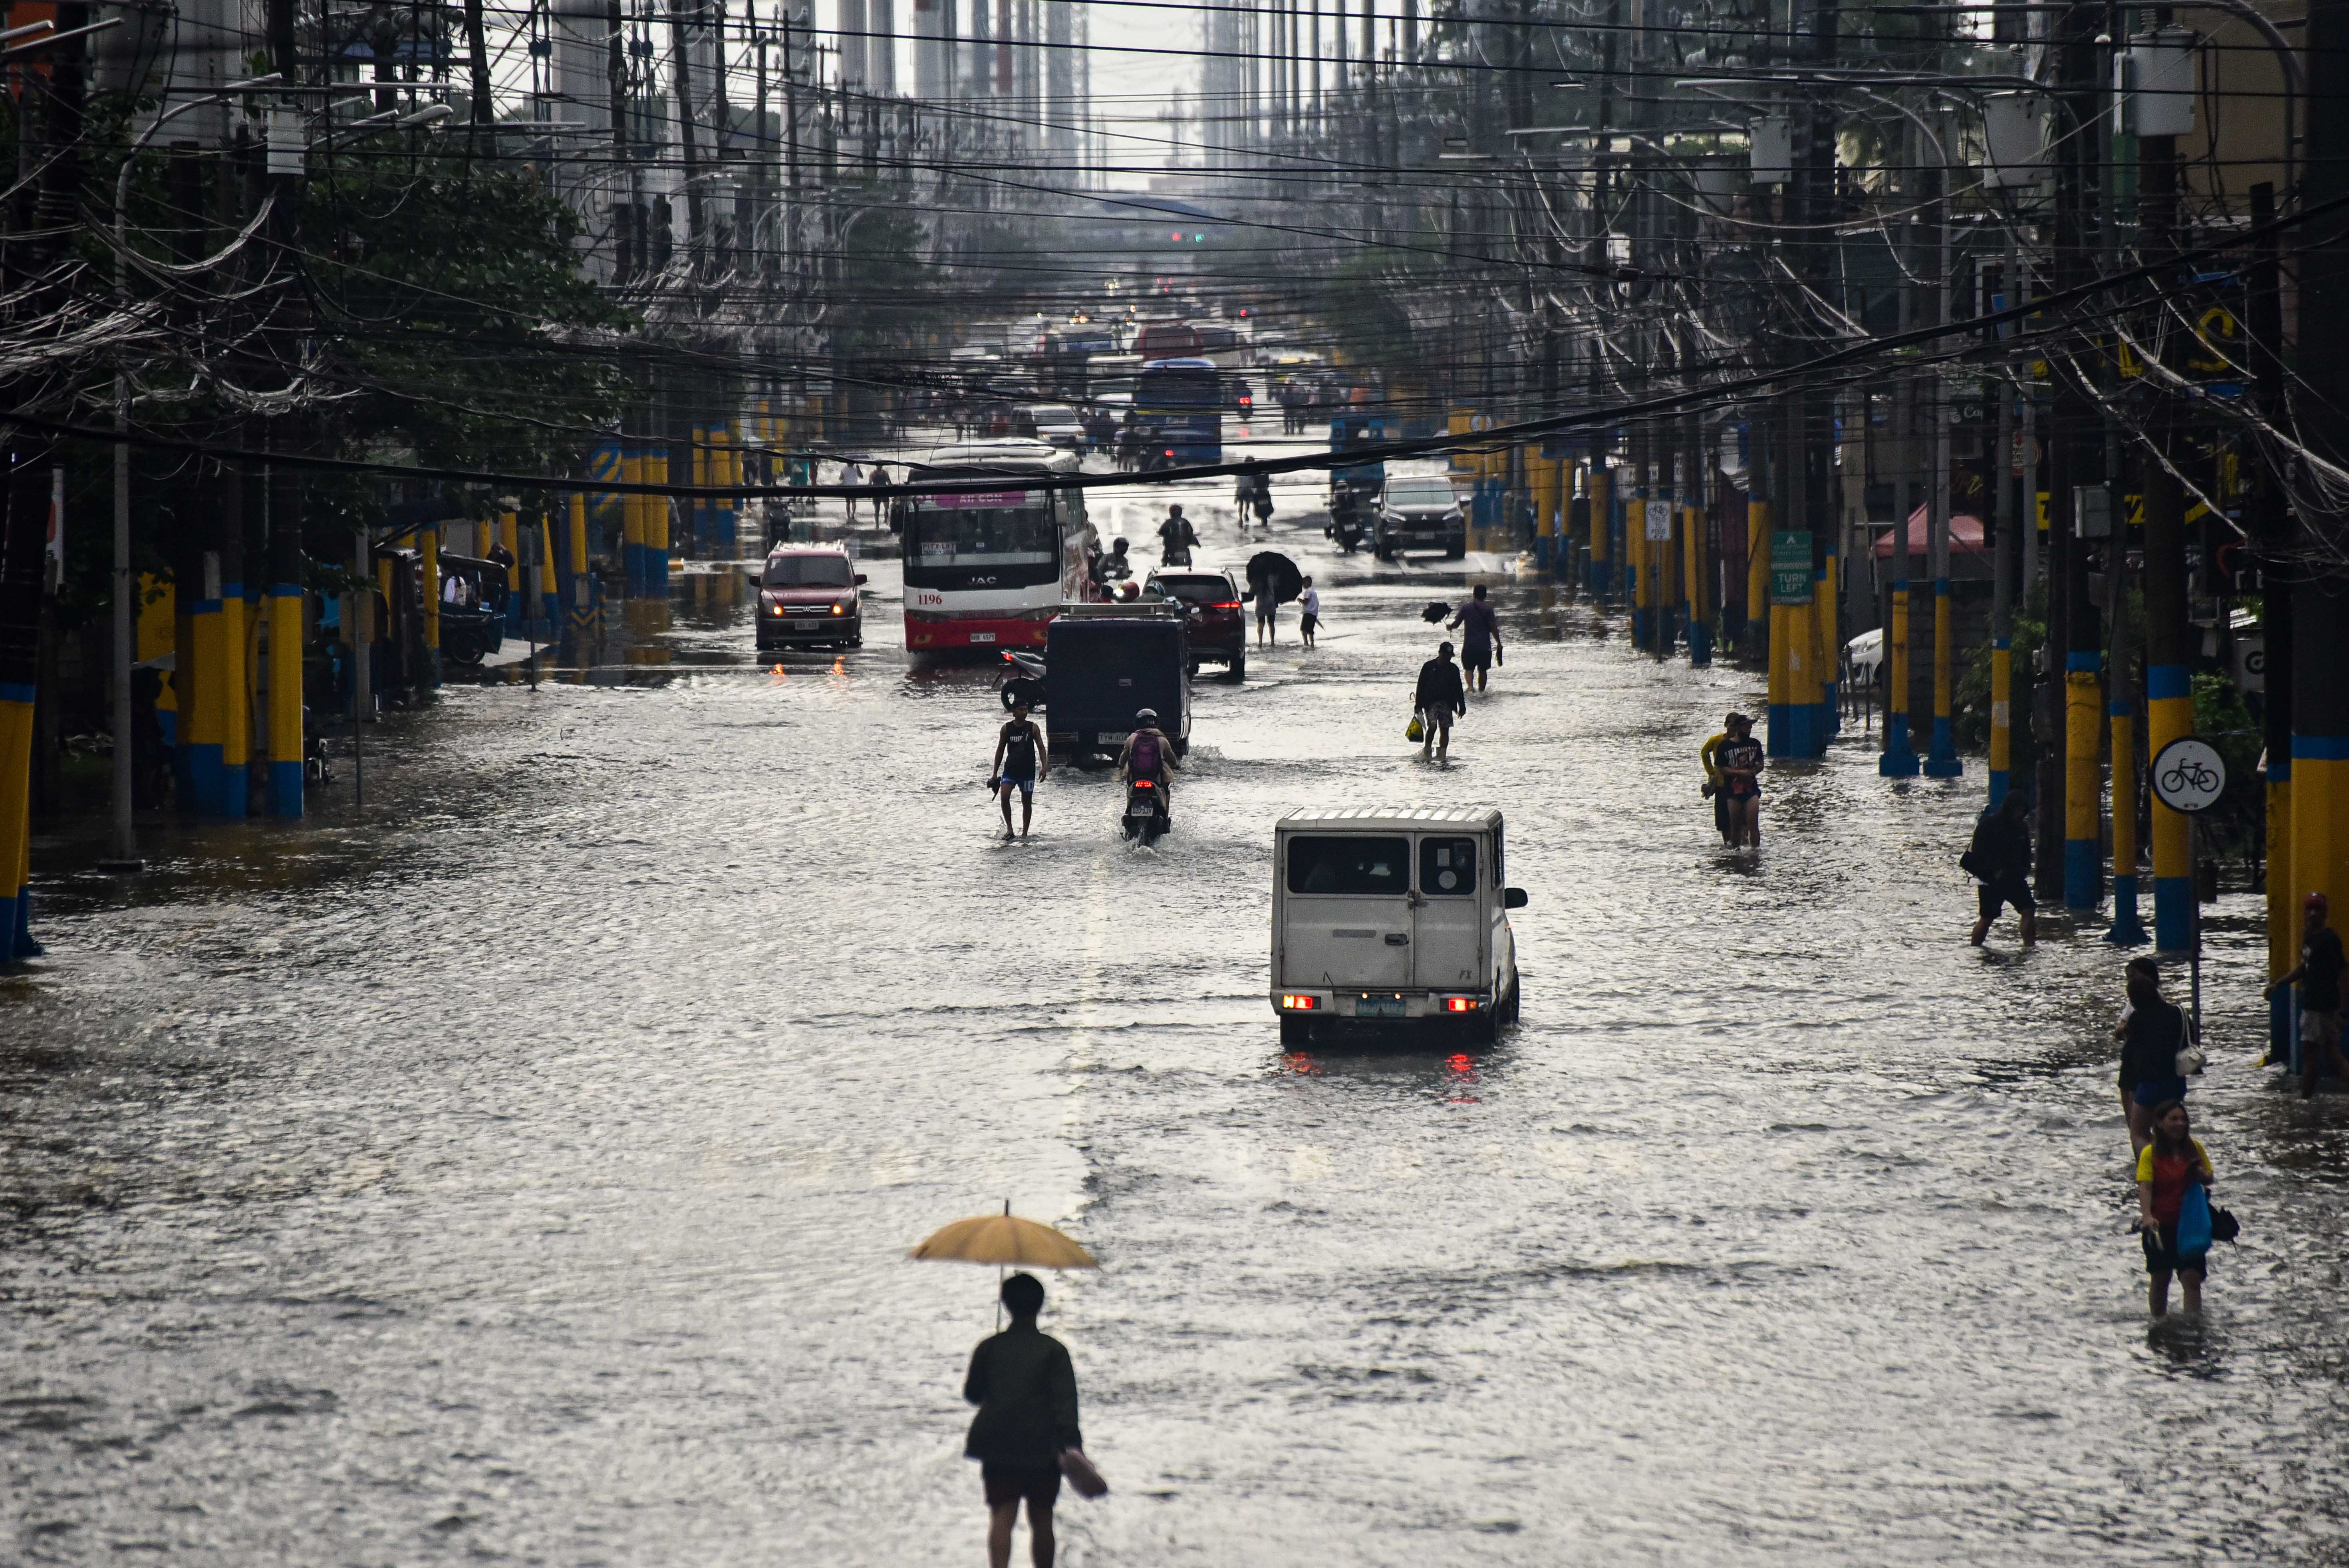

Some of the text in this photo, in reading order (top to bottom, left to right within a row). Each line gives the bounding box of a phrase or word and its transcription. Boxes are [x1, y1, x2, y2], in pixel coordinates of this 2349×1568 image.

[967, 576, 997, 585] JAC
[1777, 574, 1806, 583] TURN
[1781, 584, 1803, 592] LEFT
[918, 594, 942, 605] 1196
[1023, 780, 1034, 792] 10
